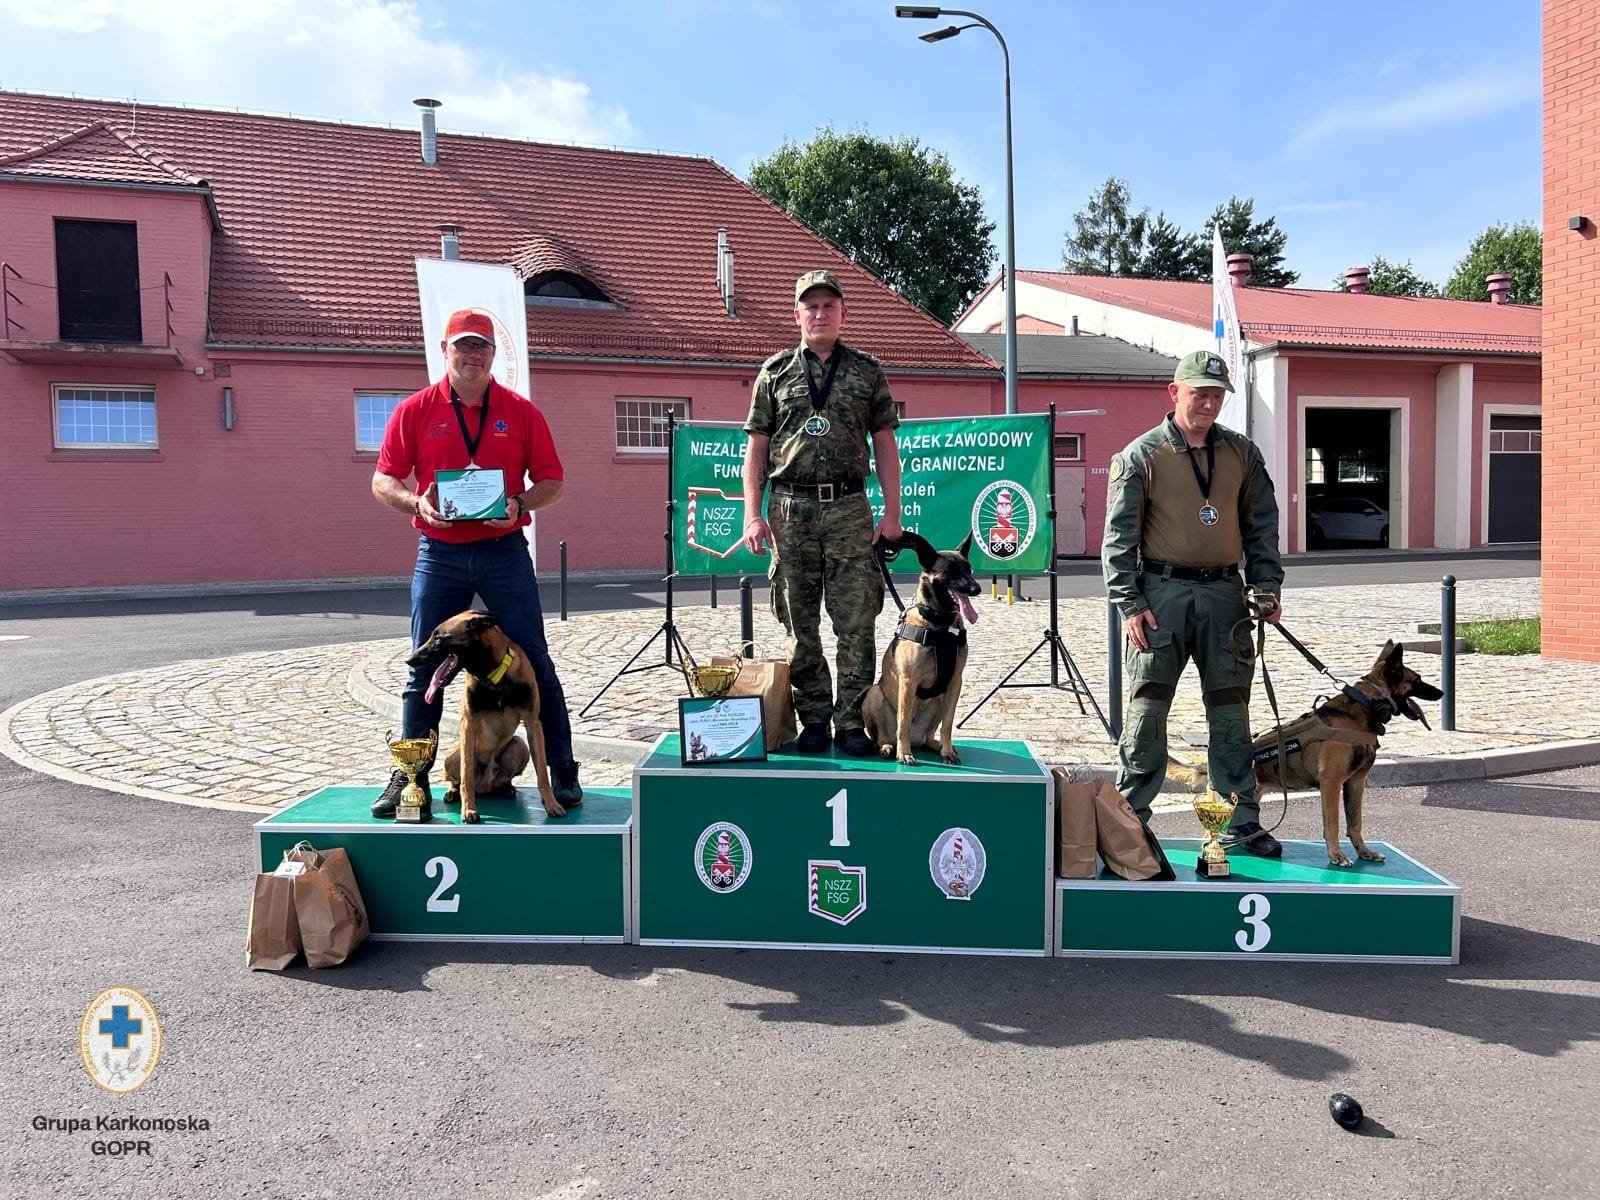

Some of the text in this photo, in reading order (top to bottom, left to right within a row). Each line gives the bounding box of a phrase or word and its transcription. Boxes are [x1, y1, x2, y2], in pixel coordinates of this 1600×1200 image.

[691, 432, 1033, 458] NIEZALE IĄZEK ZAWODOWY
[911, 456, 1005, 472] GRANICZNEJ
[1091, 467, 1109, 475] SZATN
[878, 482, 936, 497] Skoleń
[703, 507, 737, 520] NSZZ
[705, 522, 731, 536] FSG
[826, 788, 851, 847] 1
[424, 856, 460, 912] 2
[825, 879, 852, 891] NSZZ
[827, 892, 850, 904] FSG
[1235, 893, 1271, 952] 3
